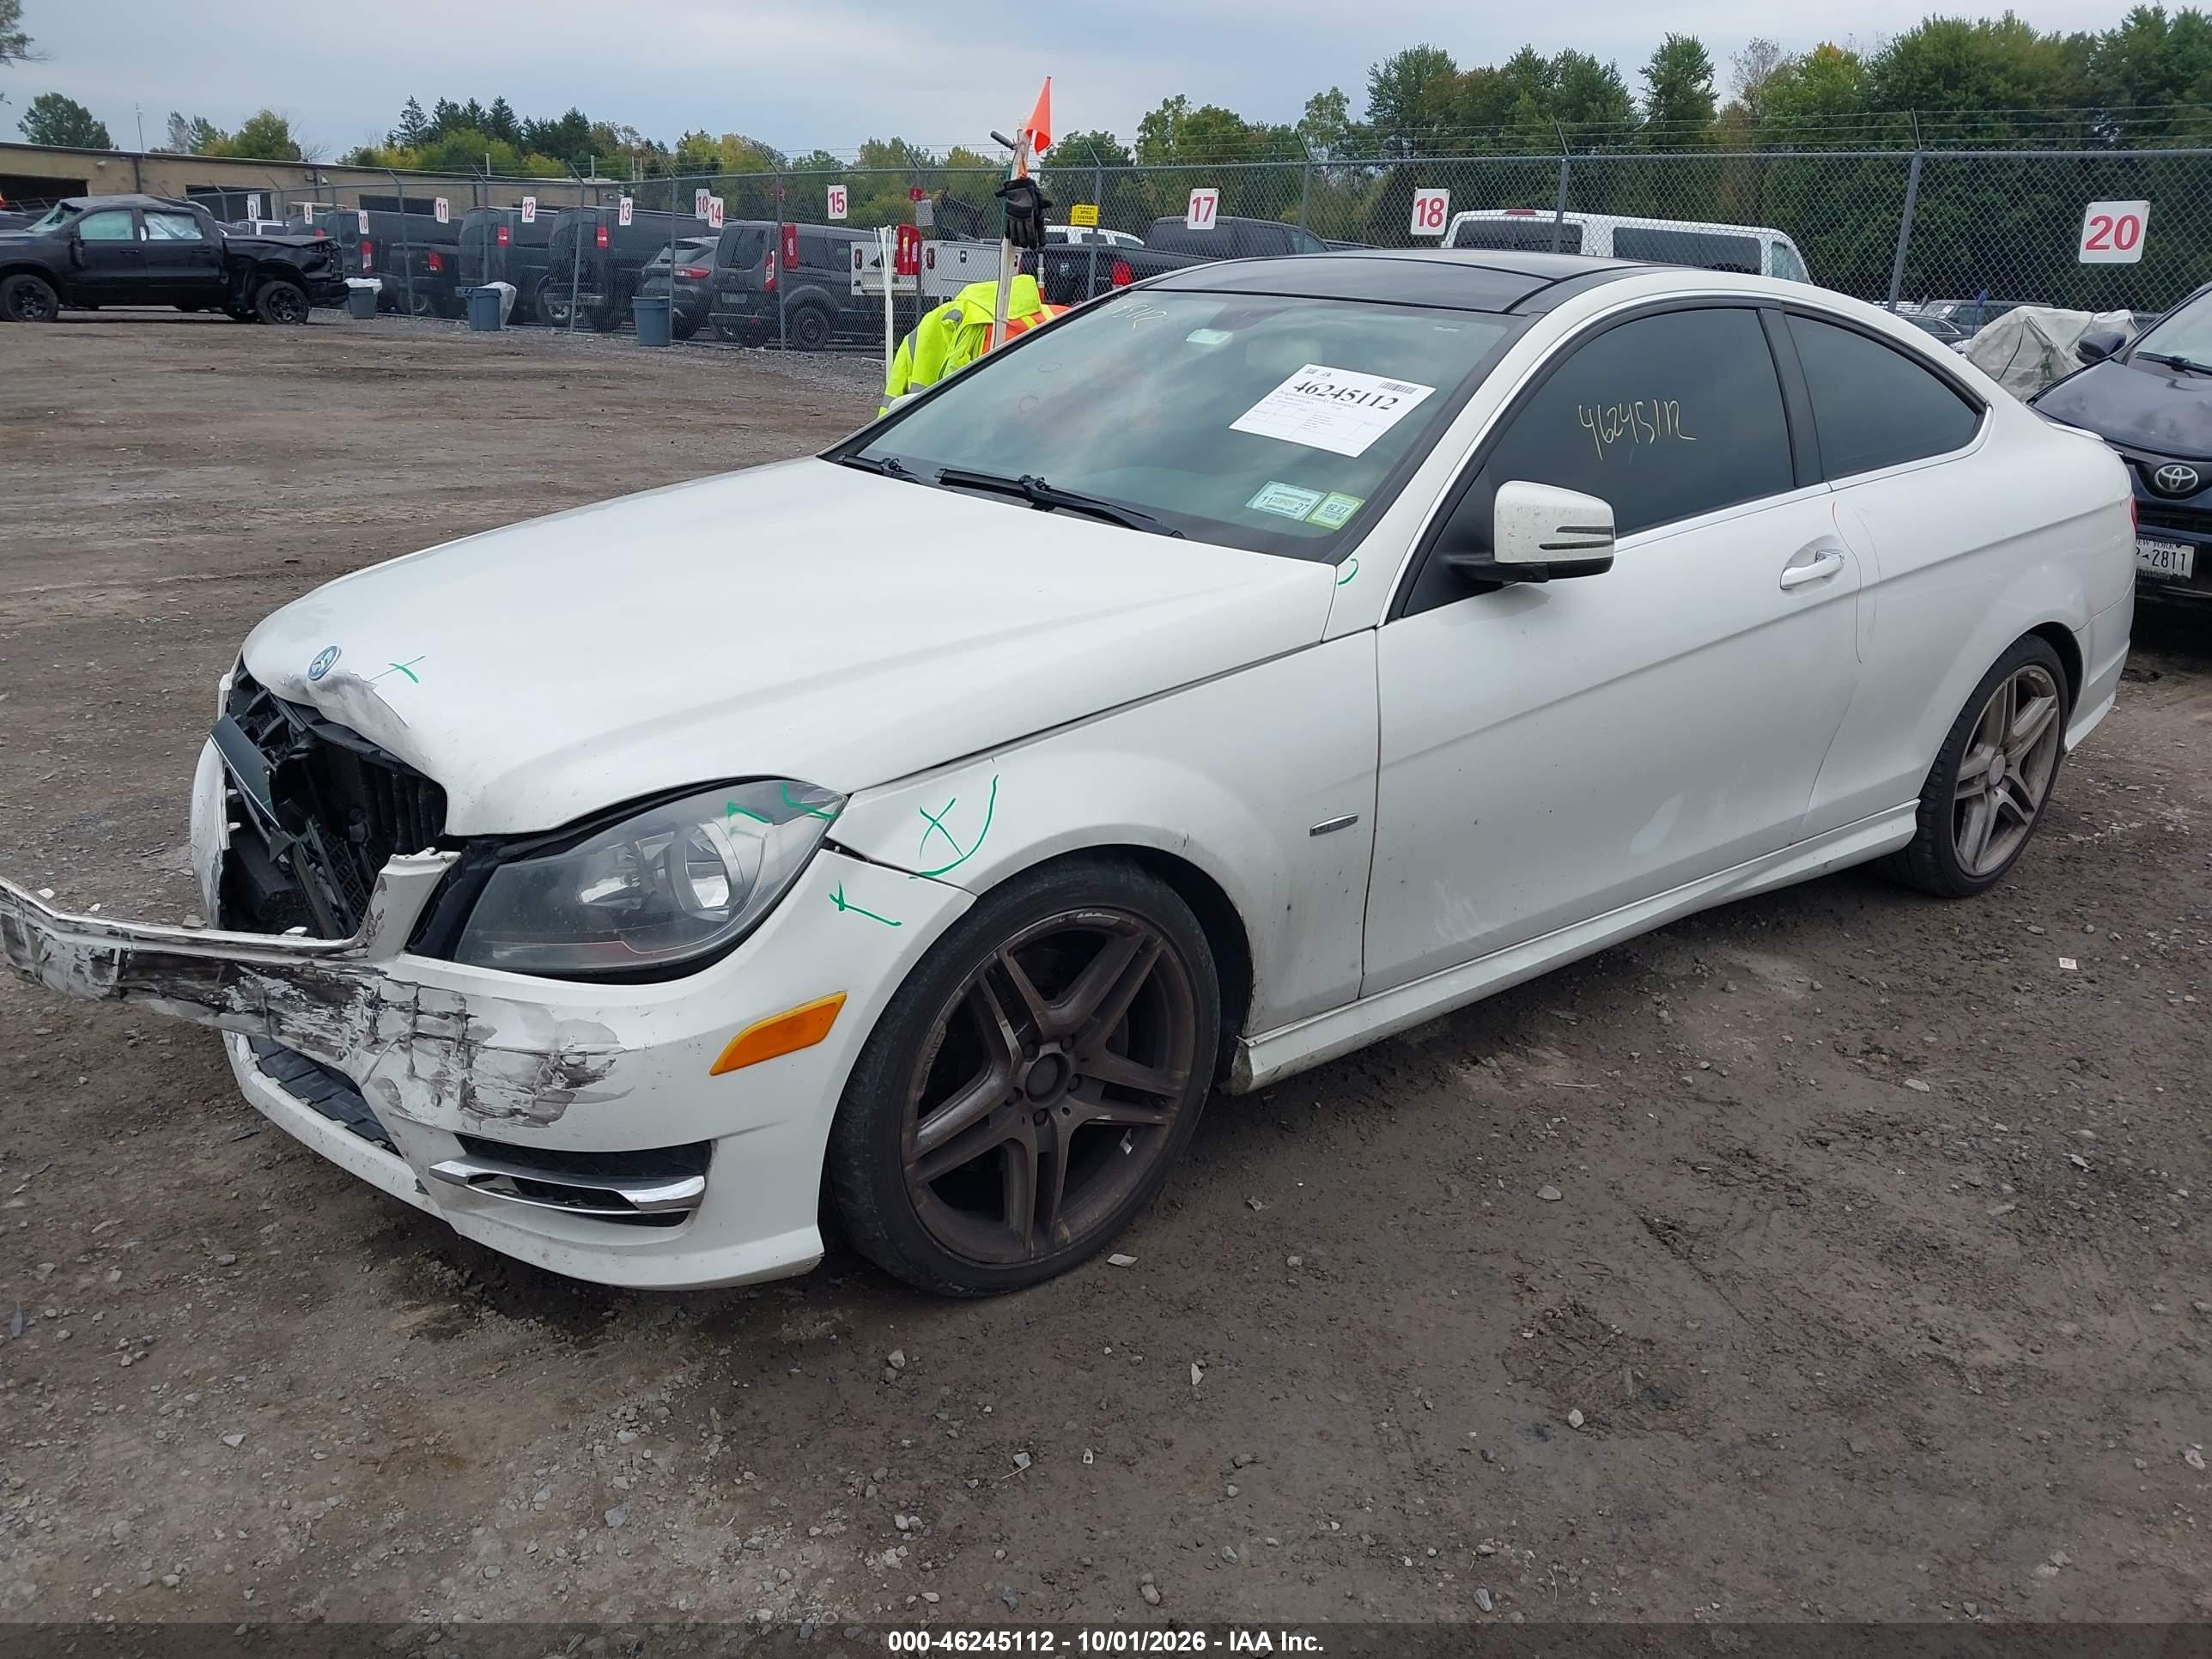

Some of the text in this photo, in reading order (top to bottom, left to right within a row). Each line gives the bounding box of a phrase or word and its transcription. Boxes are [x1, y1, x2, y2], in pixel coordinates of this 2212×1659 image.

[249, 204, 255, 218] 8
[438, 203, 447, 219] 11
[524, 201, 534, 218] 12
[621, 202, 631, 221] 13
[697, 196, 708, 213] 10
[830, 191, 845, 213] 15
[1192, 196, 1215, 222] 17
[306, 206, 311, 221] 9
[710, 203, 722, 223] 14
[1416, 198, 1445, 228] 18
[360, 216, 368, 230] 10
[2086, 214, 2140, 250] 20
[1293, 380, 1399, 410] 46245112
[1578, 398, 1697, 461] 46245112
[1294, 502, 1310, 512] 27
